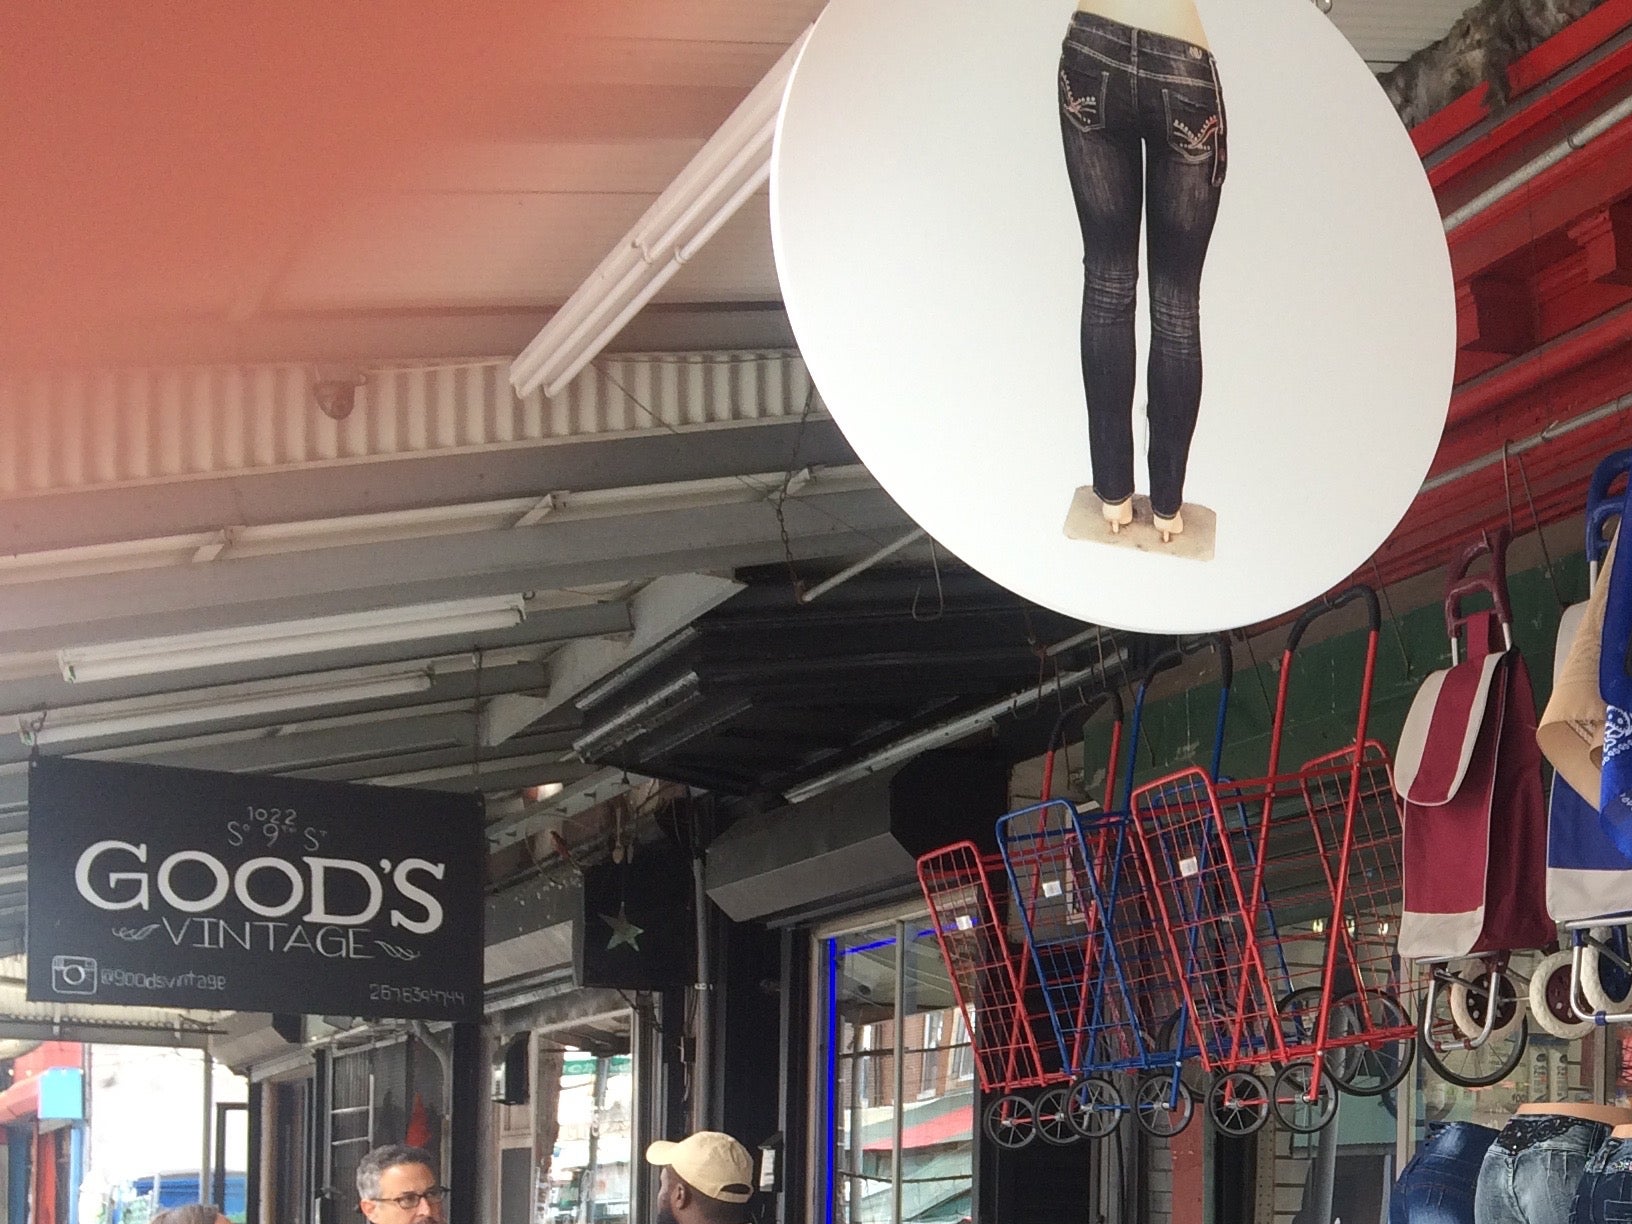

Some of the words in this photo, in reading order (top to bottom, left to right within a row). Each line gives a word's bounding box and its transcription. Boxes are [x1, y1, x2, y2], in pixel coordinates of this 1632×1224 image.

[248, 806, 297, 826] 1022
[74, 840, 446, 935] GOOD'S
[161, 916, 376, 960] VINTAGE
